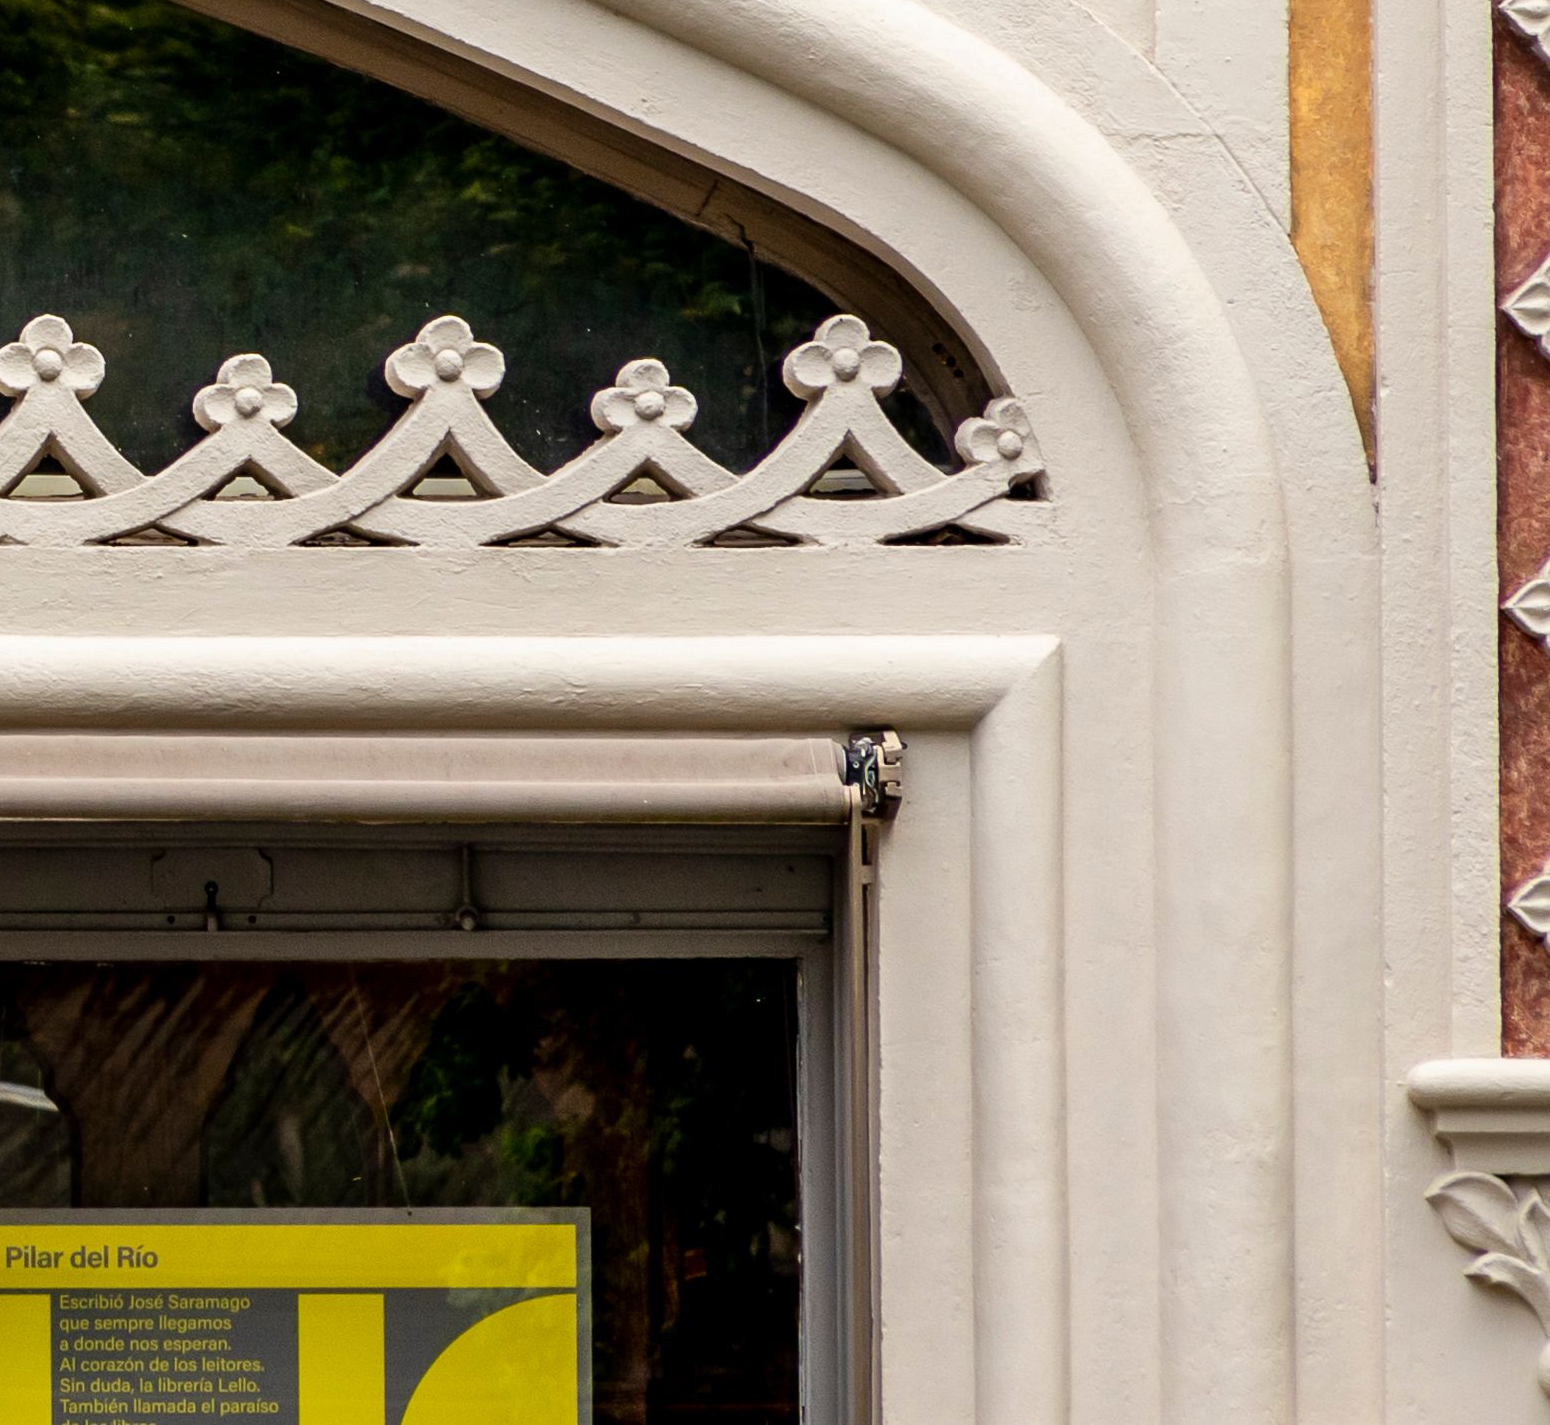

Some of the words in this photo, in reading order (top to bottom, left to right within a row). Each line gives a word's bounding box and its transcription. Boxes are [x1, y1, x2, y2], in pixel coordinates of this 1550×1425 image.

[6, 1246, 63, 1269] Pilar
[70, 1246, 108, 1269] del
[118, 1244, 159, 1269] Río
[60, 1295, 123, 1309] Escribió
[129, 1295, 163, 1309] José
[169, 1295, 251, 1313] Saramago
[60, 1319, 90, 1333] que
[95, 1319, 154, 1333] sempre
[159, 1316, 232, 1333] llegamos
[60, 1339, 68, 1351] a
[74, 1337, 125, 1351] donde
[131, 1339, 158, 1351] nos
[164, 1339, 232, 1355] esperan.
[60, 1358, 75, 1372] Al
[81, 1358, 144, 1372] corazón
[150, 1358, 169, 1372] de
[174, 1358, 196, 1372] los
[203, 1358, 264, 1372] leitores.
[60, 1379, 85, 1393] Sin
[91, 1379, 134, 1396] duda,
[140, 1379, 152, 1393] la
[159, 1379, 213, 1393] librería
[219, 1379, 260, 1393] Lello.
[60, 1399, 128, 1414] También
[134, 1399, 196, 1414] llamada
[201, 1399, 215, 1414] el
[221, 1399, 278, 1417] paraíso
